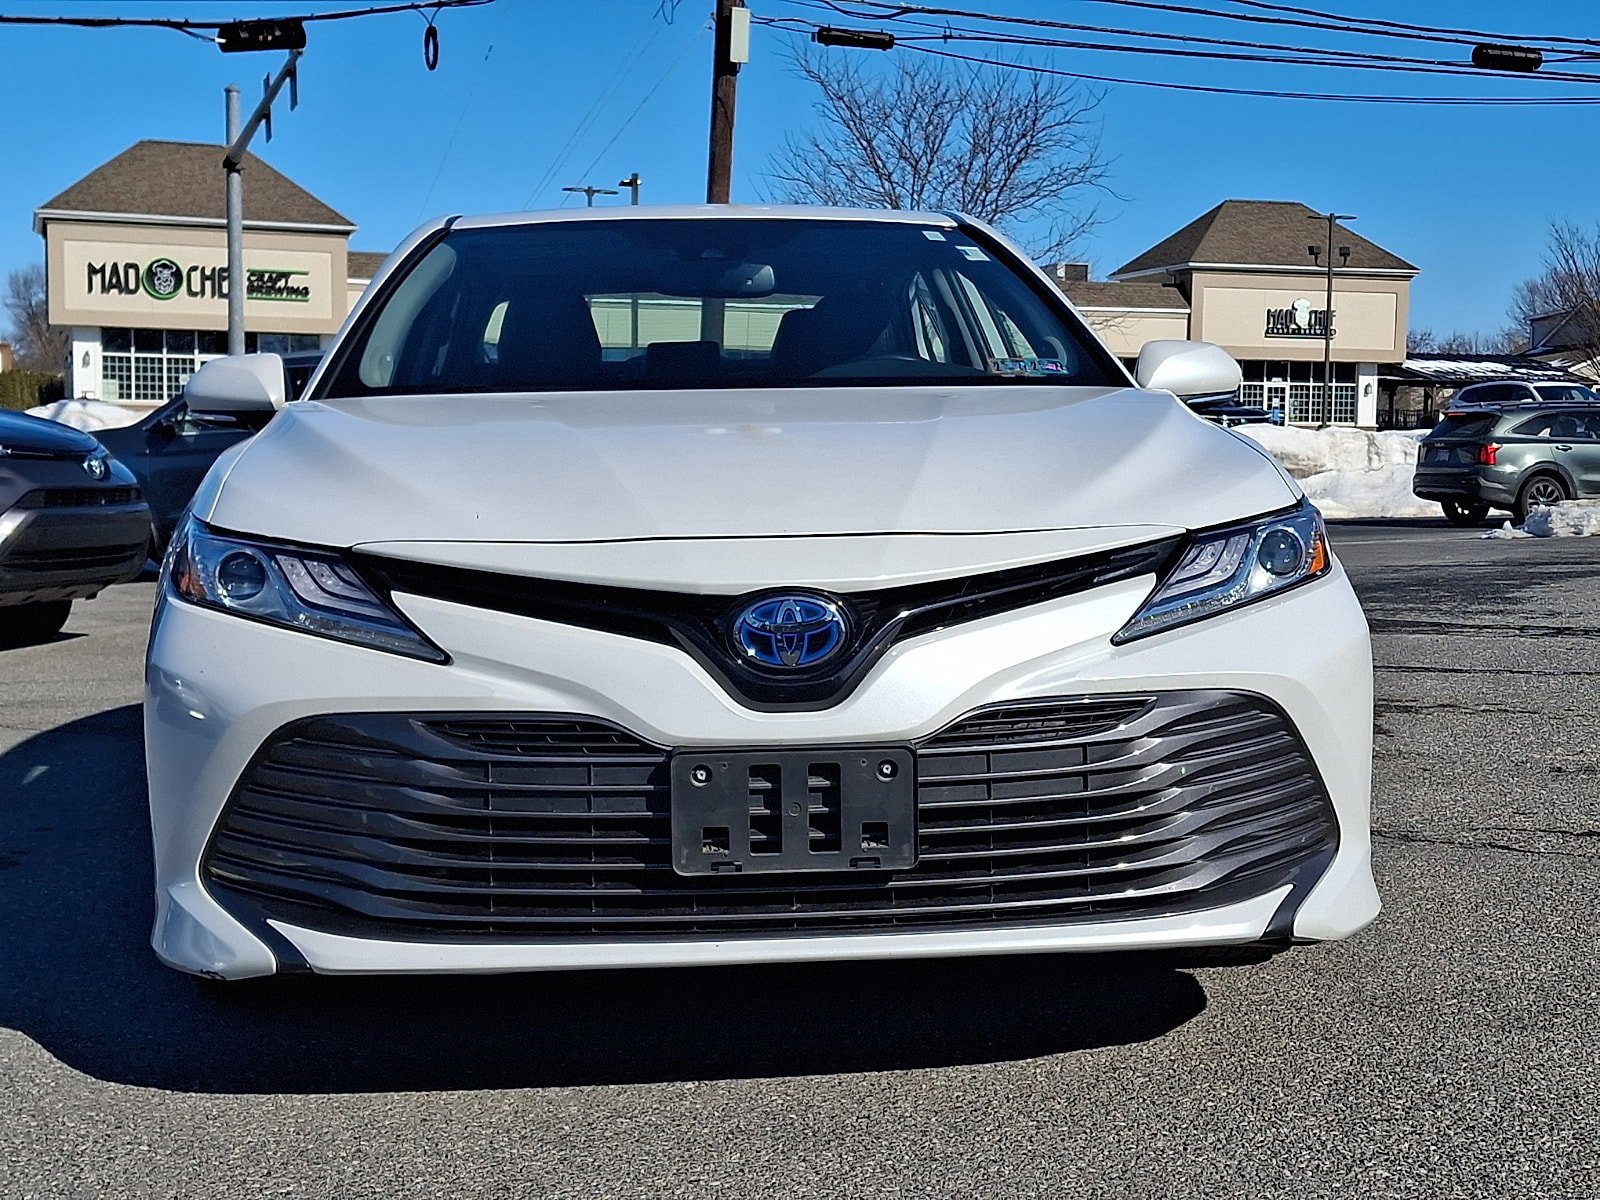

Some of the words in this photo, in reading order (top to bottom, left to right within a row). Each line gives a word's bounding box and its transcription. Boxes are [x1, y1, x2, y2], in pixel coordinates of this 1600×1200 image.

[87, 261, 139, 295] MAD
[186, 265, 229, 299] CHE
[247, 270, 291, 284] CRAFT
[1266, 308, 1294, 328] MAD
[1300, 328, 1337, 336] BREWIG
